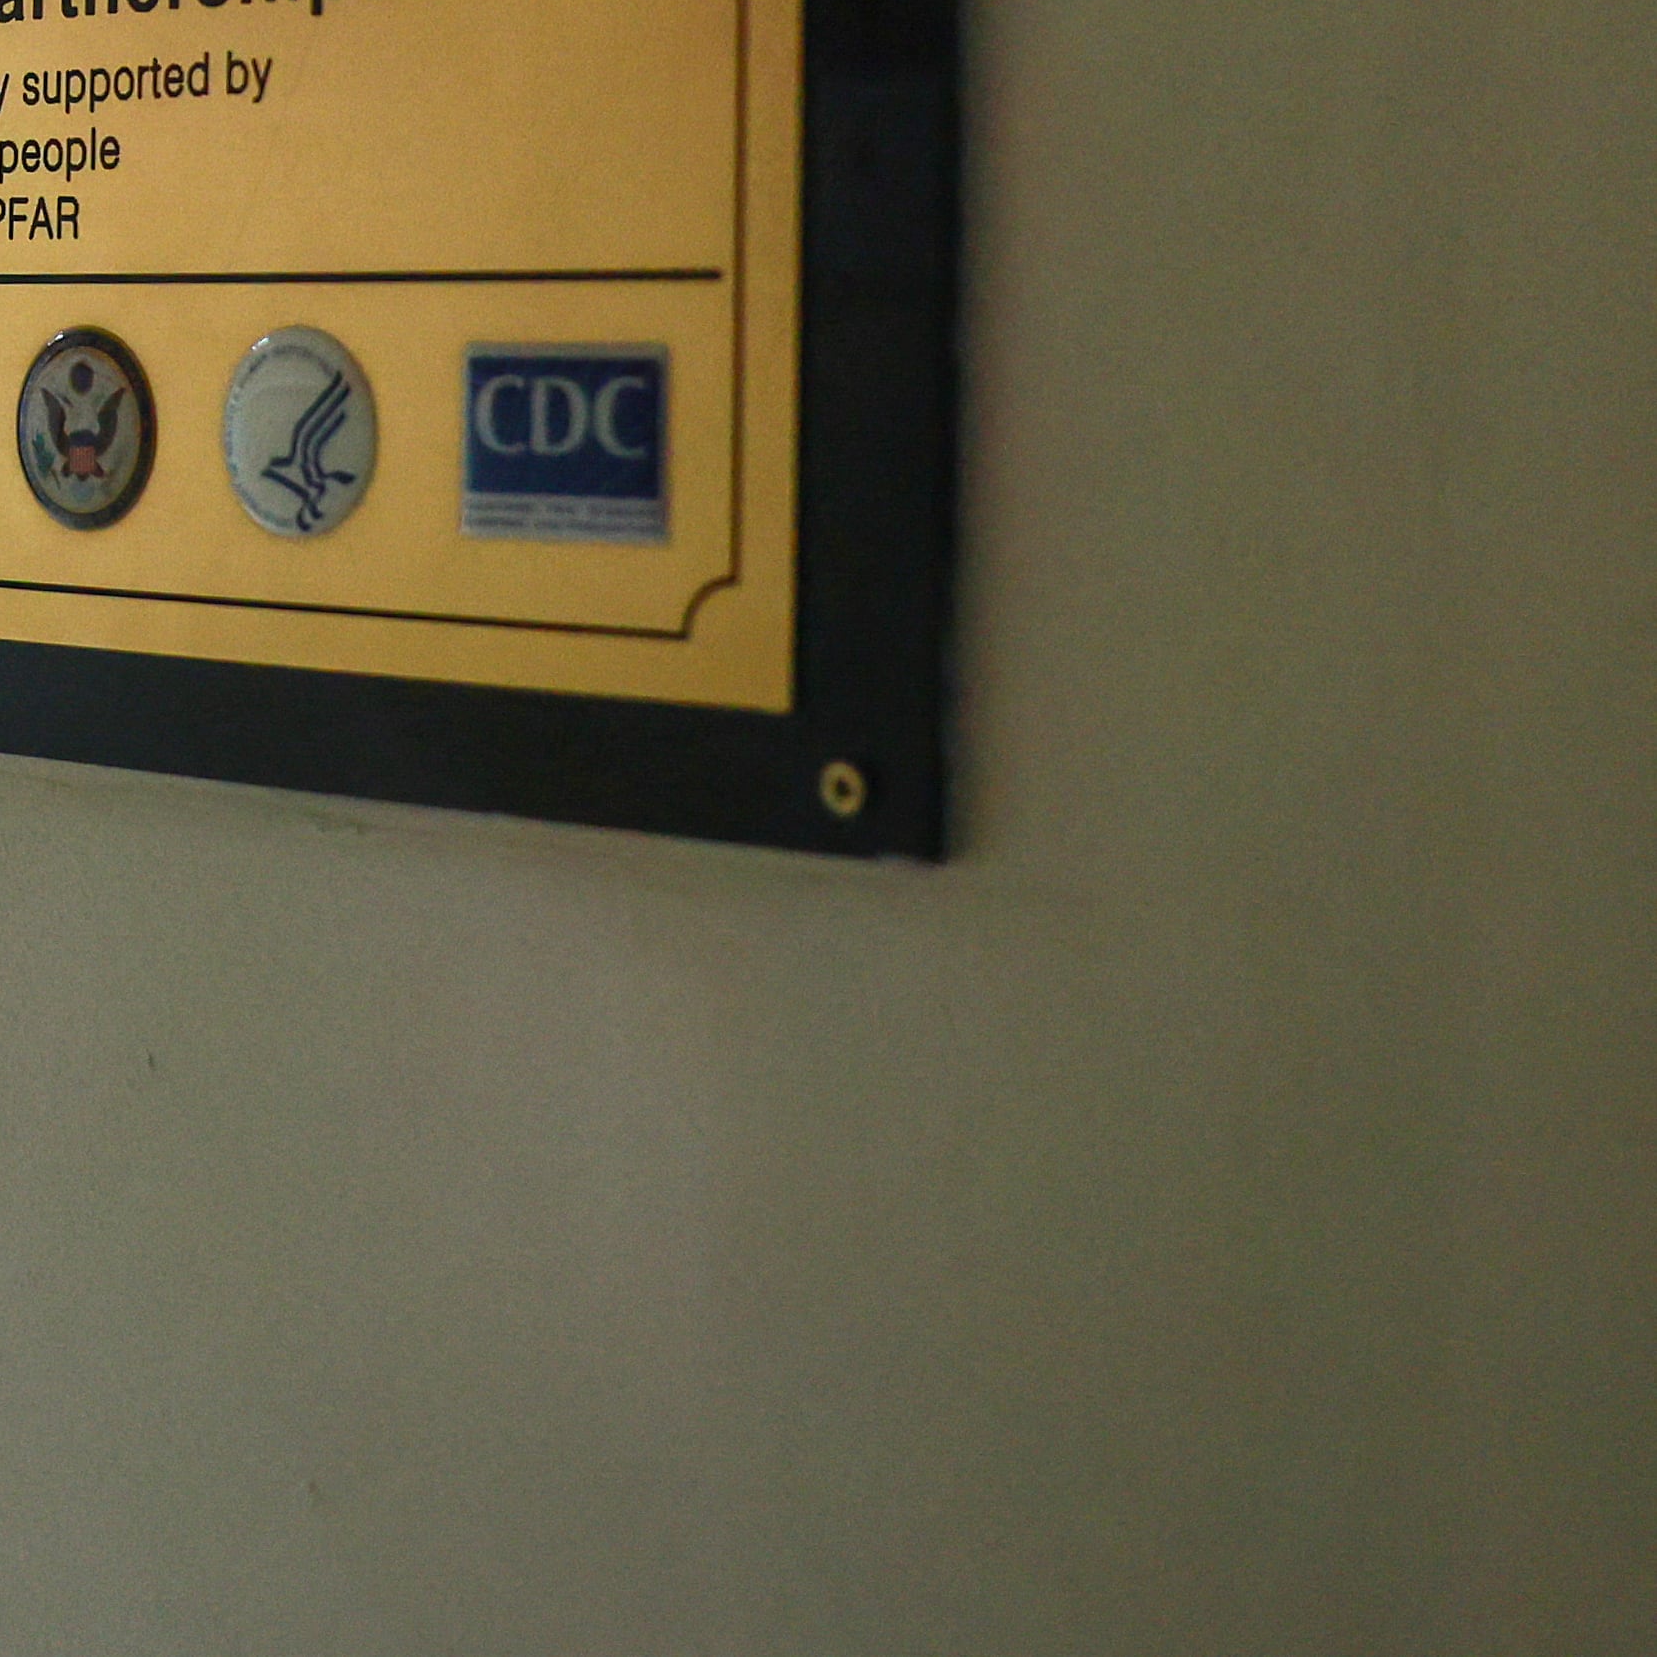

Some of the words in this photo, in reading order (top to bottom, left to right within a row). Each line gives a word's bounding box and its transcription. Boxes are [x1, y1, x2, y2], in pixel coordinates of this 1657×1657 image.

[21, 50, 211, 116] supported
[224, 49, 274, 105] by
[475, 373, 646, 458] CDC
